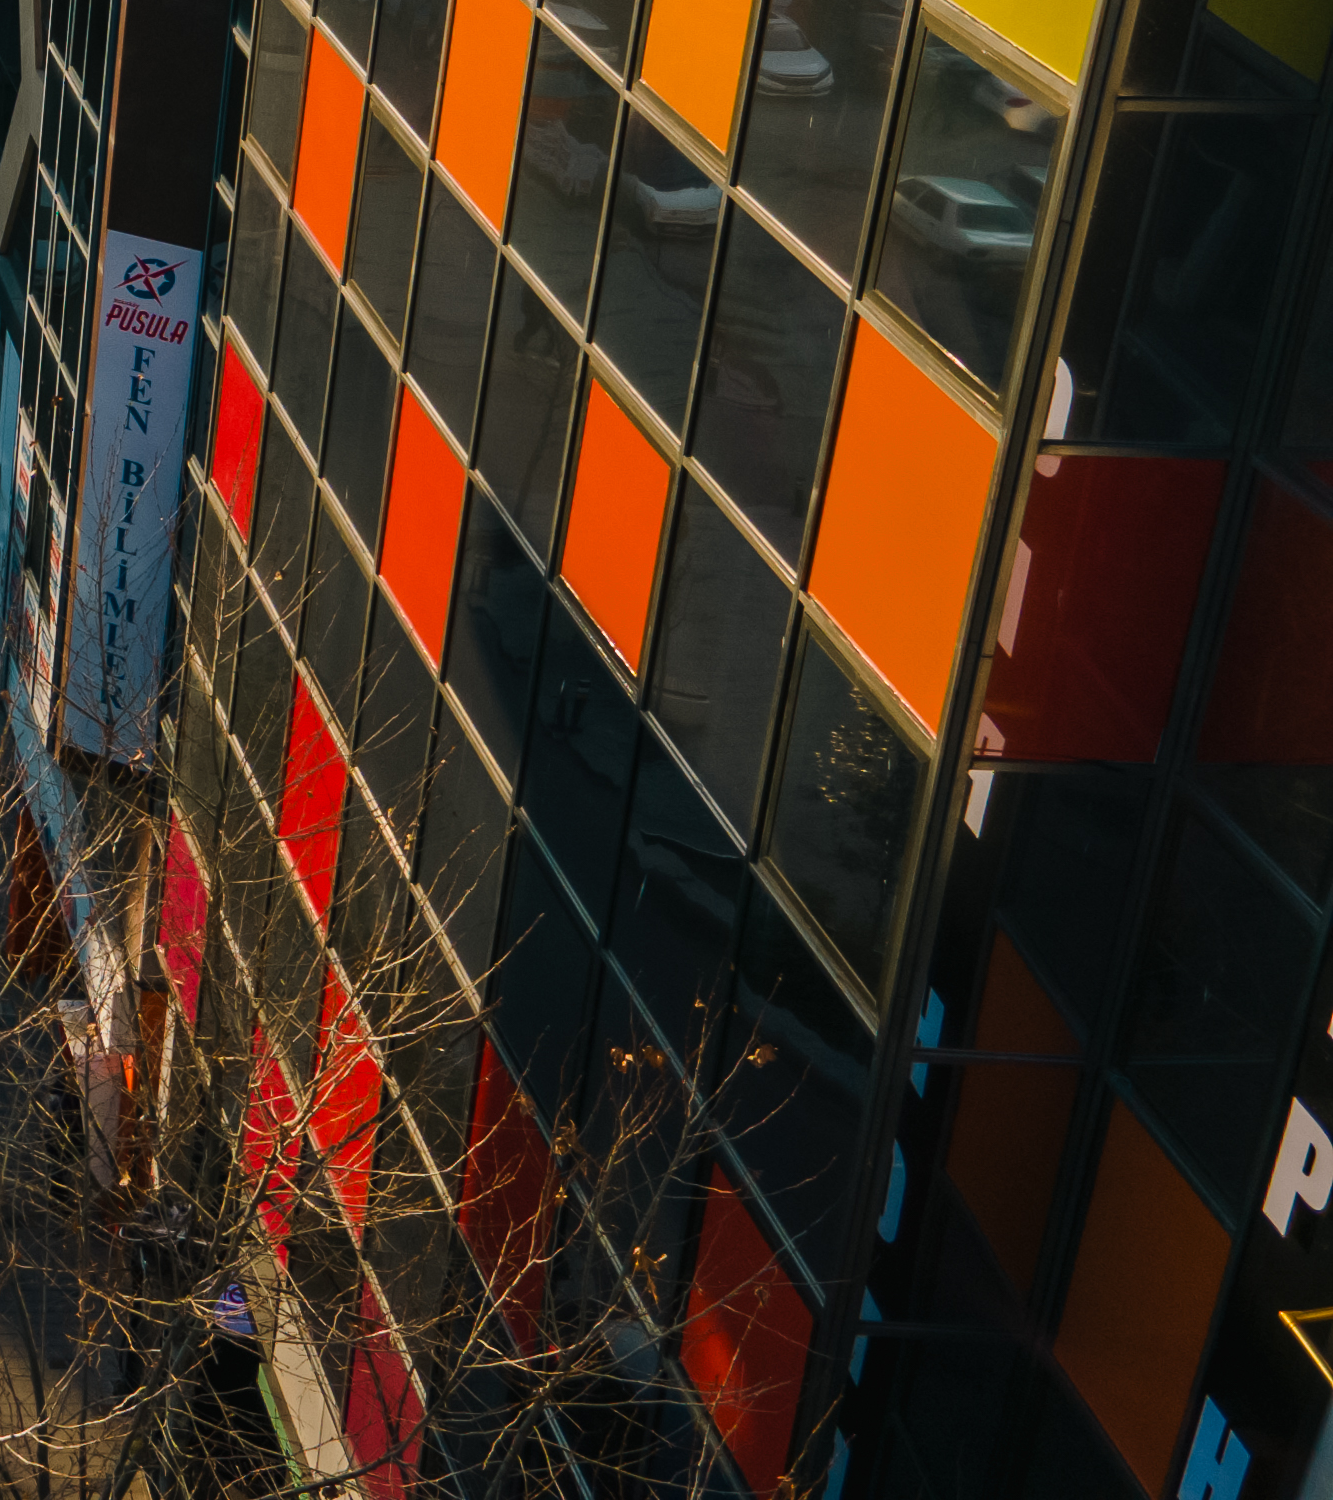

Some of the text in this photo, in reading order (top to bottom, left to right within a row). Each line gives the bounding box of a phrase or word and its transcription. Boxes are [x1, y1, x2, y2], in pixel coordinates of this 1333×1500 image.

[105, 303, 189, 345] PUSULA
[124, 345, 156, 435] FEN
[100, 458, 145, 726] BİLİMLER
